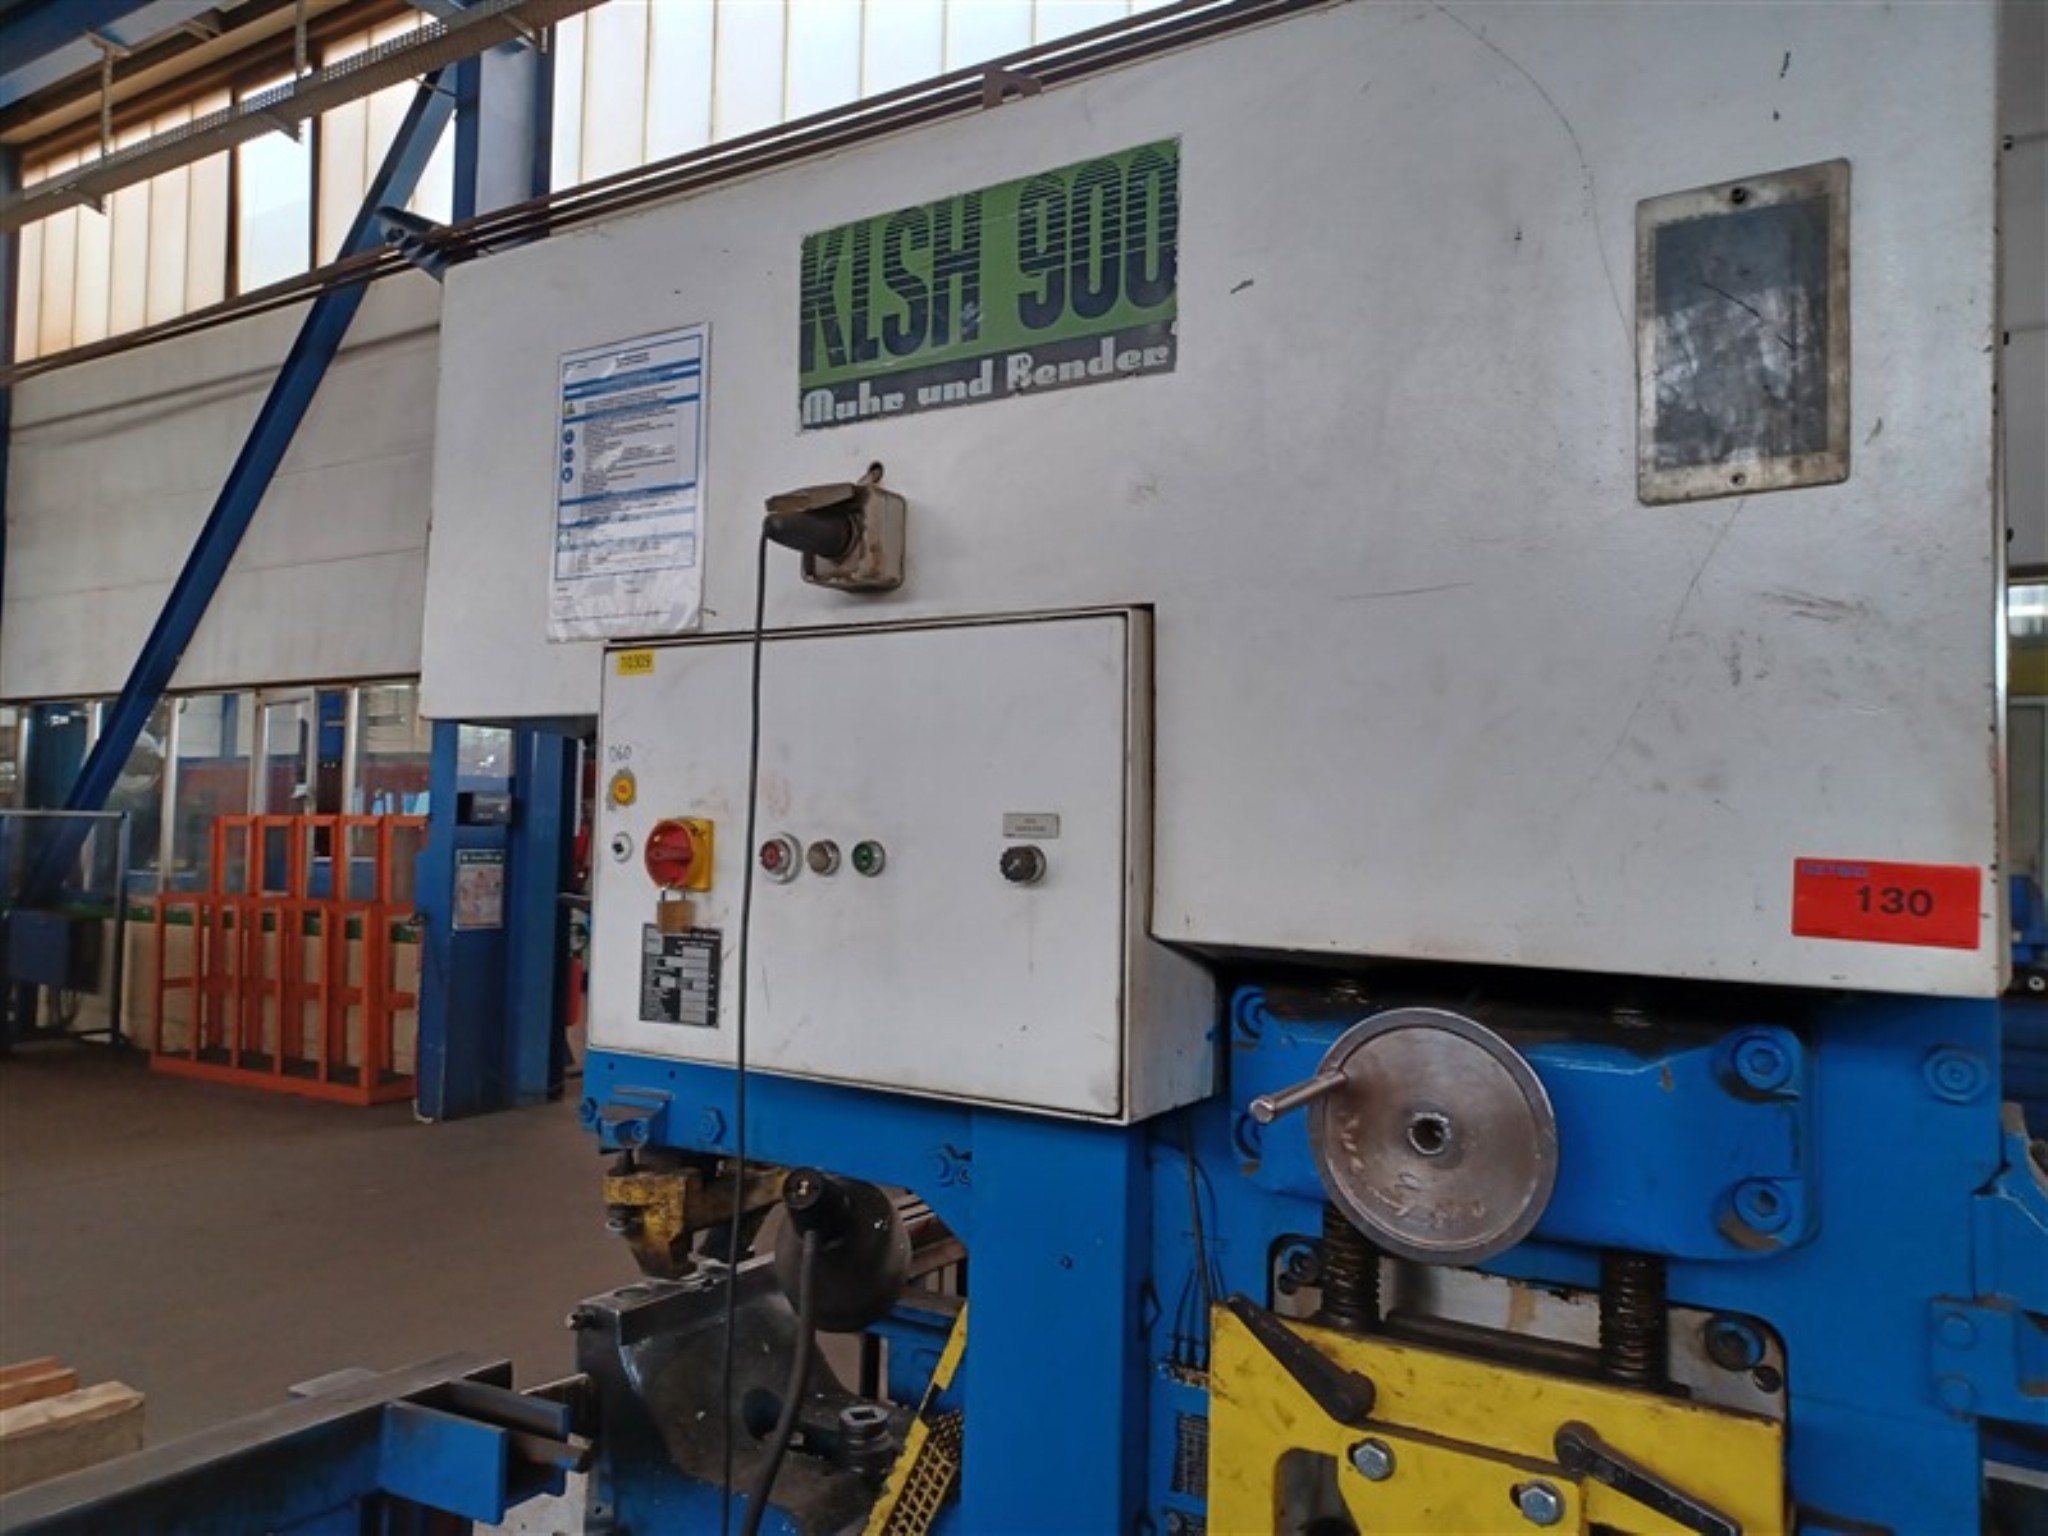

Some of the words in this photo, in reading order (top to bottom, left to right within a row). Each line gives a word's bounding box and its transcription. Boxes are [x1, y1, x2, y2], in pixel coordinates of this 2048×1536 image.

[801, 189, 983, 374] KLSH
[1017, 146, 1179, 330] 900
[917, 358, 994, 405] und
[1856, 884, 1934, 917] 130
